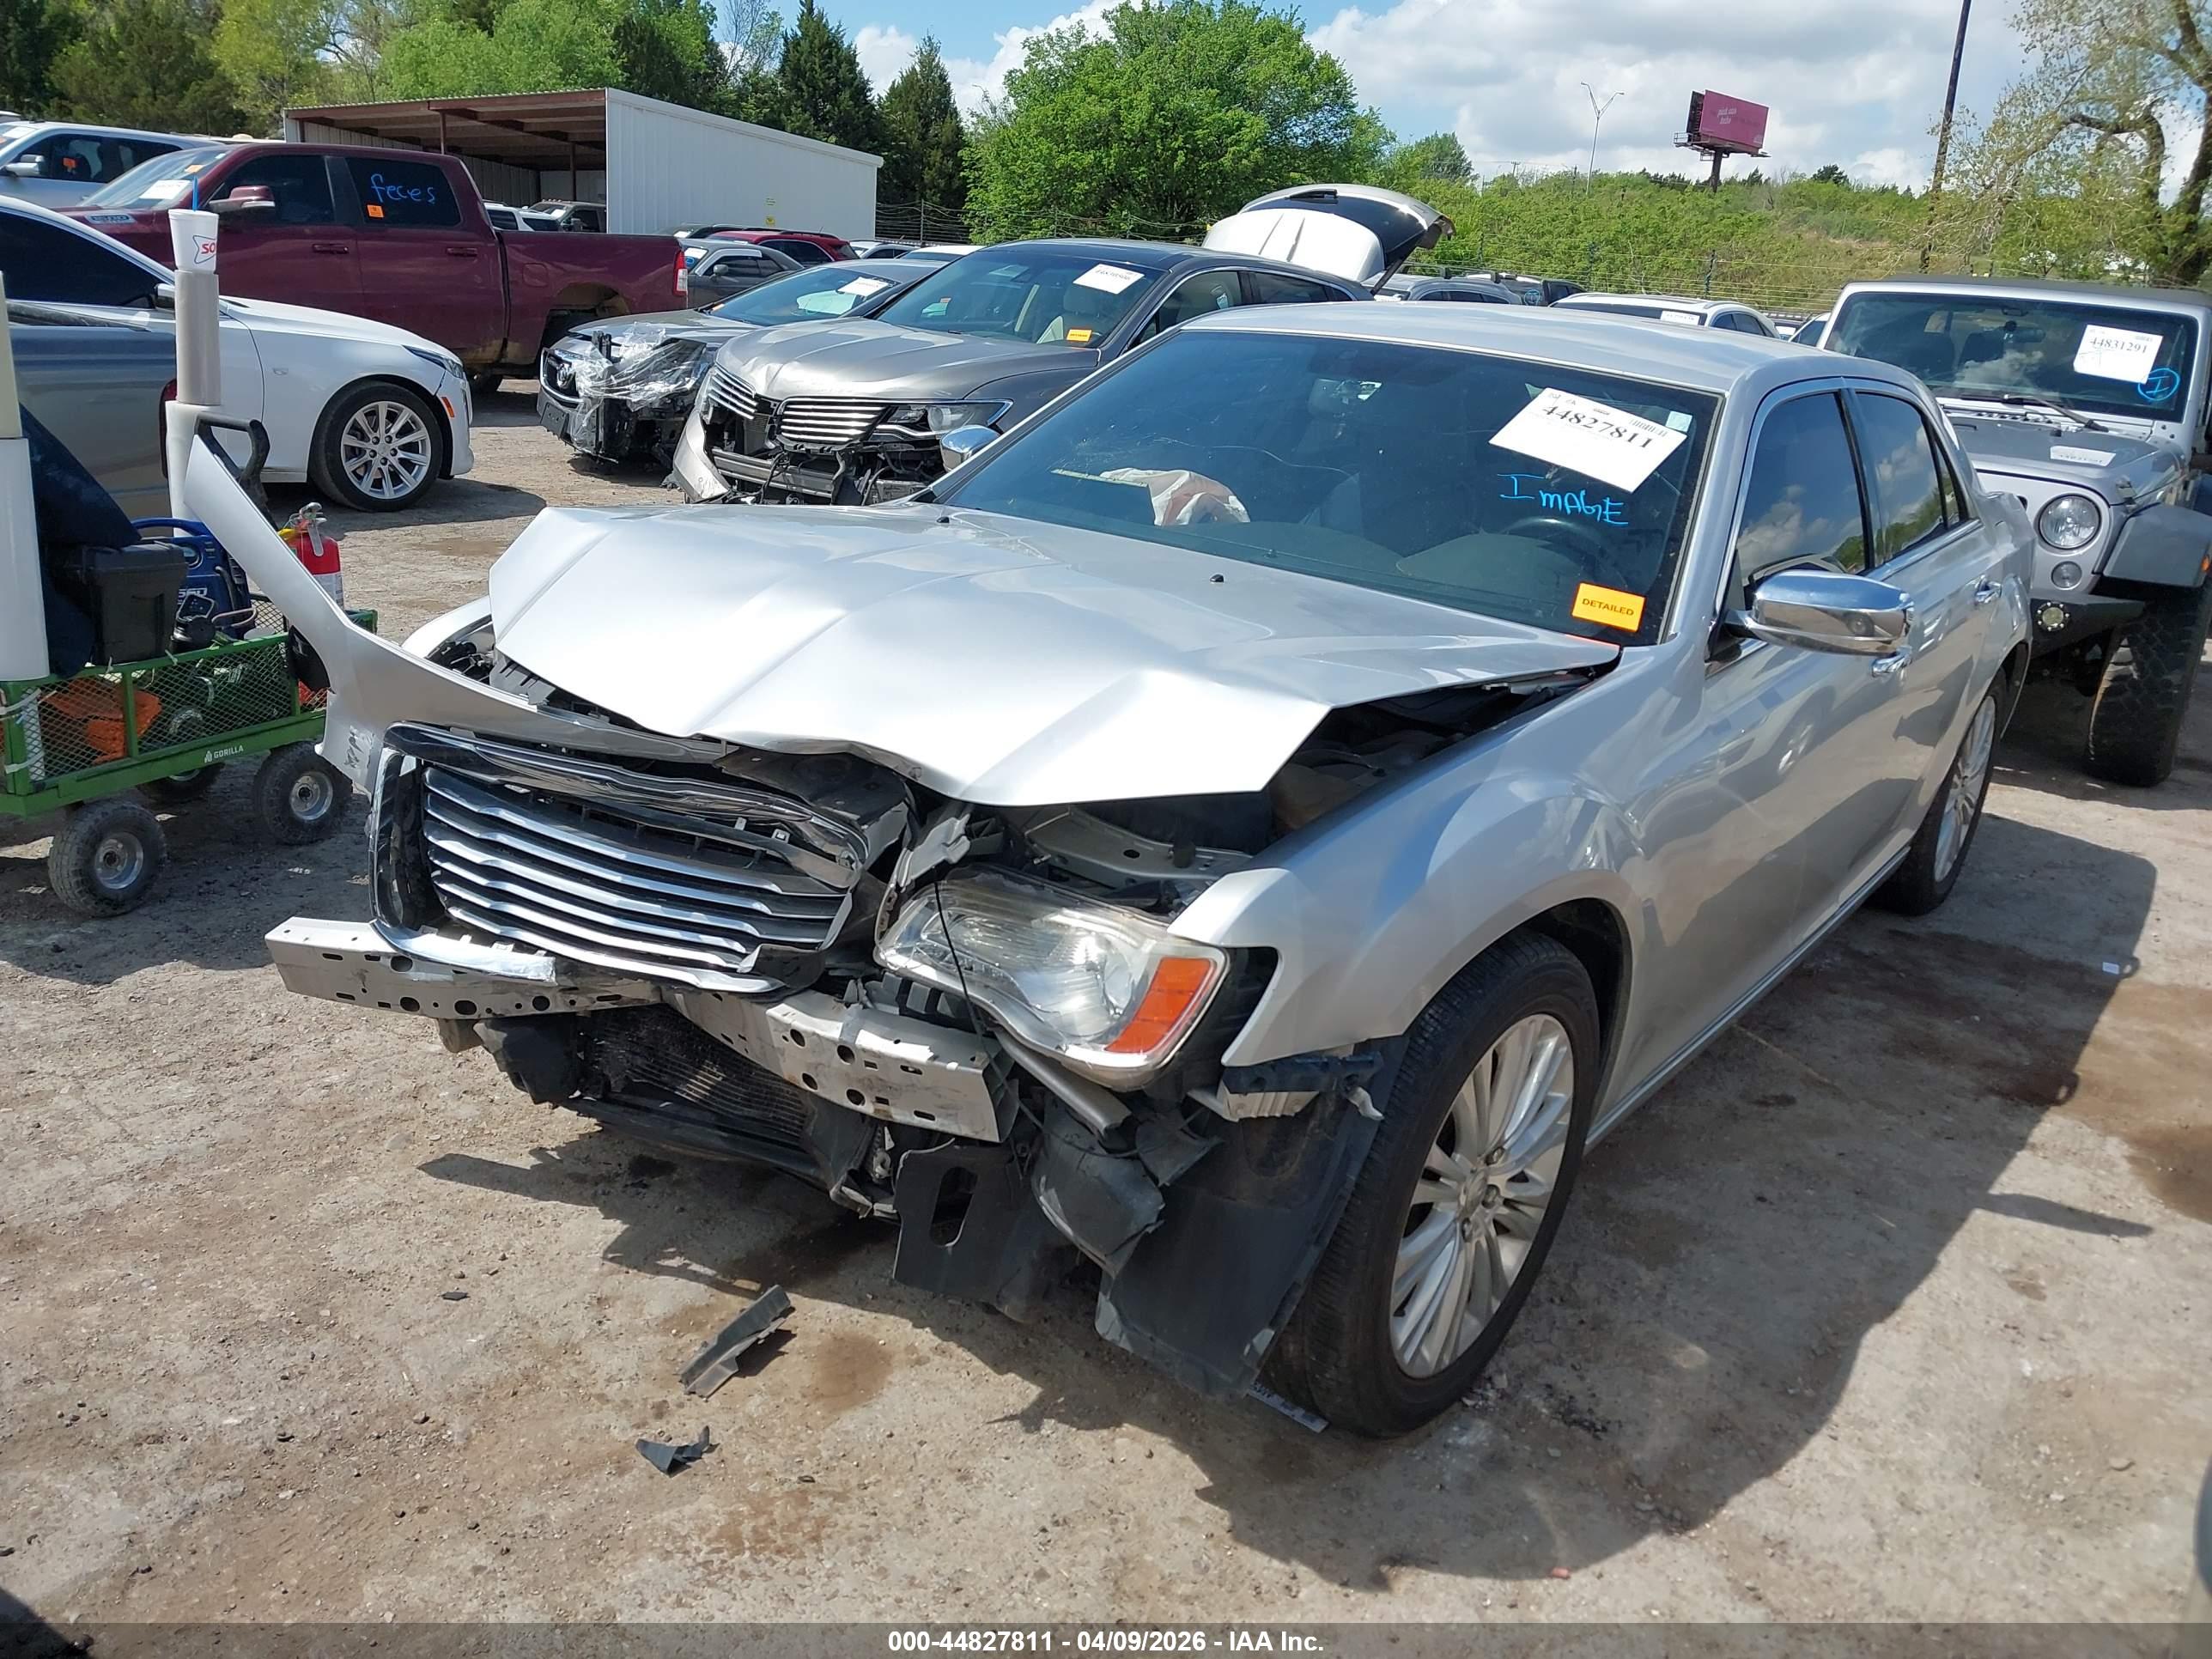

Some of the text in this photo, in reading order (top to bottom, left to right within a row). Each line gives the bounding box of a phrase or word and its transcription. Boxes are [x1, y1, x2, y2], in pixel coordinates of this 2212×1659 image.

[370, 173, 435, 204] feces
[2089, 337, 2147, 354] 44831291
[1542, 406, 1653, 448] 44827811
[1582, 598, 1634, 616] DETAILED
[213, 744, 244, 758] GORILLA
